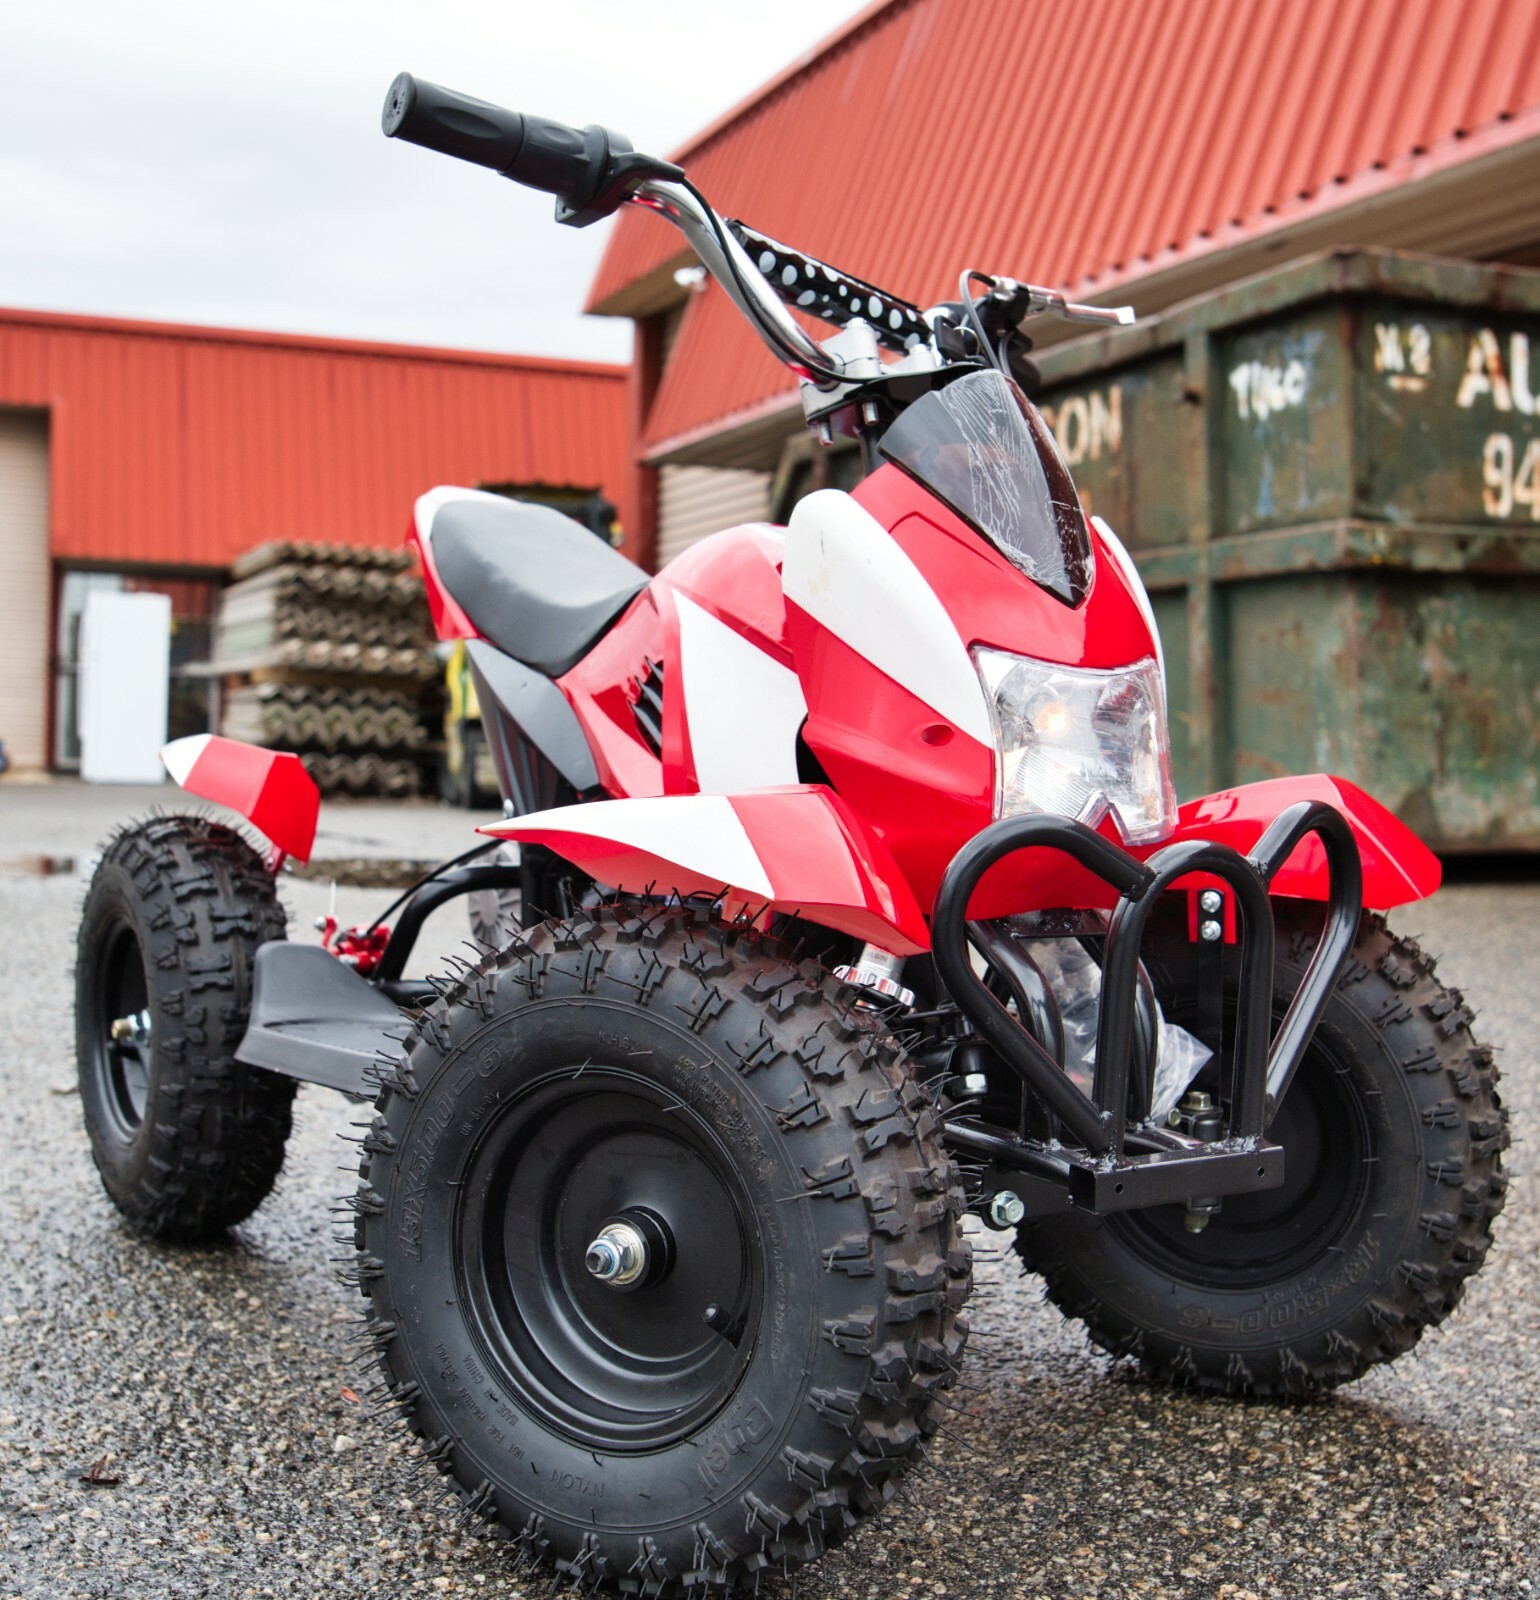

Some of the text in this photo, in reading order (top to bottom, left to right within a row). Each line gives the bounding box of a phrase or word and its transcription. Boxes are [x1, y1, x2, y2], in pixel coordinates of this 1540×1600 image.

[1042, 384, 1123, 466] ON
[701, 1075, 730, 1105] RATING
[731, 1107, 767, 1161] TUBELESS
[462, 1354, 485, 1385] CHINA
[434, 1343, 525, 1461] NOT FOR HIGHWAY SERVICE
[495, 1402, 520, 1427] MADE
[551, 1469, 606, 1499] NYLON
